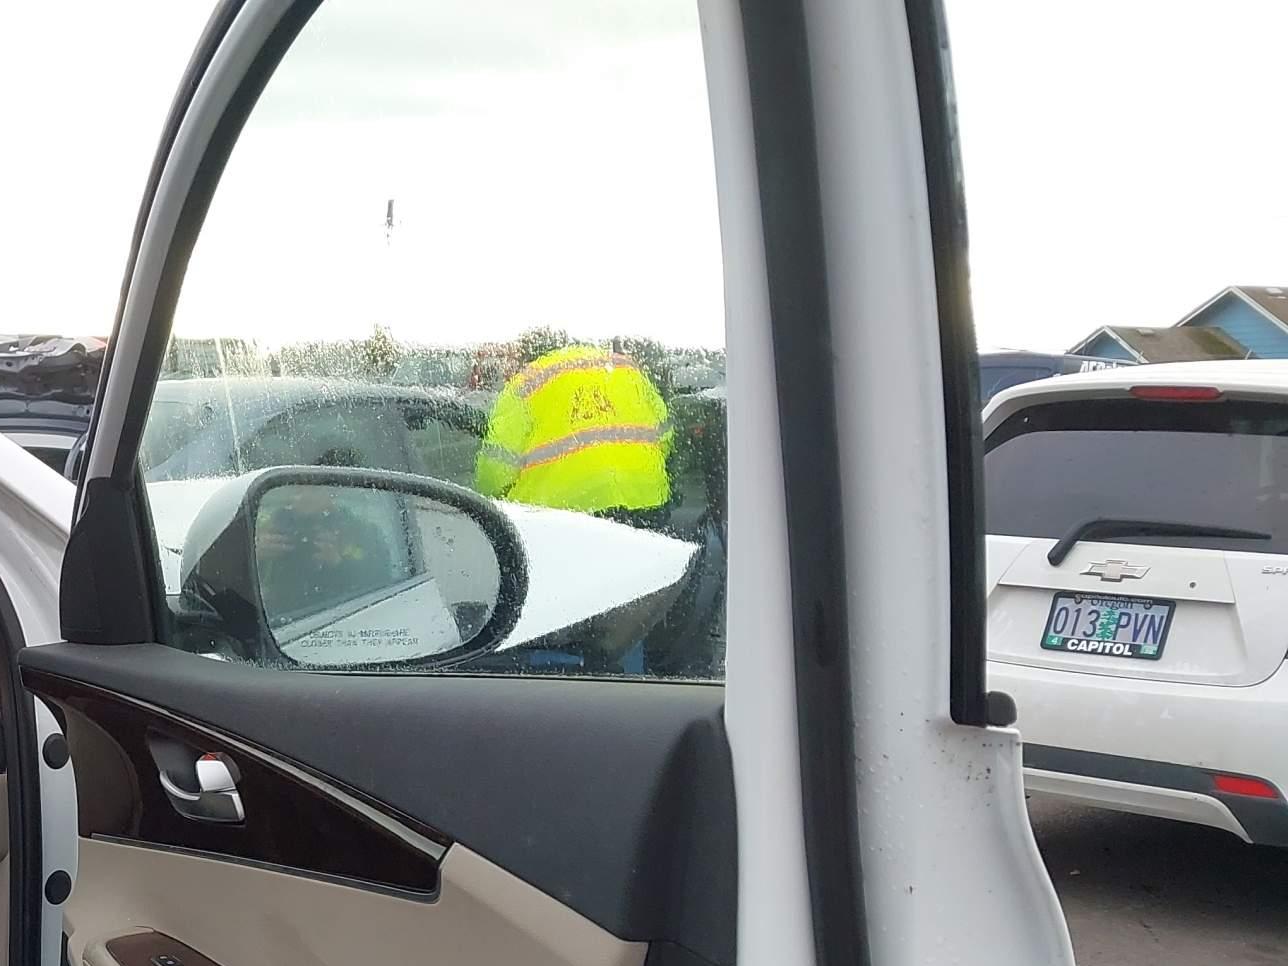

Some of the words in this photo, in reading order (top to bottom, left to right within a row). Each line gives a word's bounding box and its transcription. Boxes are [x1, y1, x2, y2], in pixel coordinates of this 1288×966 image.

[1053, 606, 1102, 638] 013
[1112, 611, 1165, 645] PVN
[1066, 639, 1133, 656] CAPITOL
